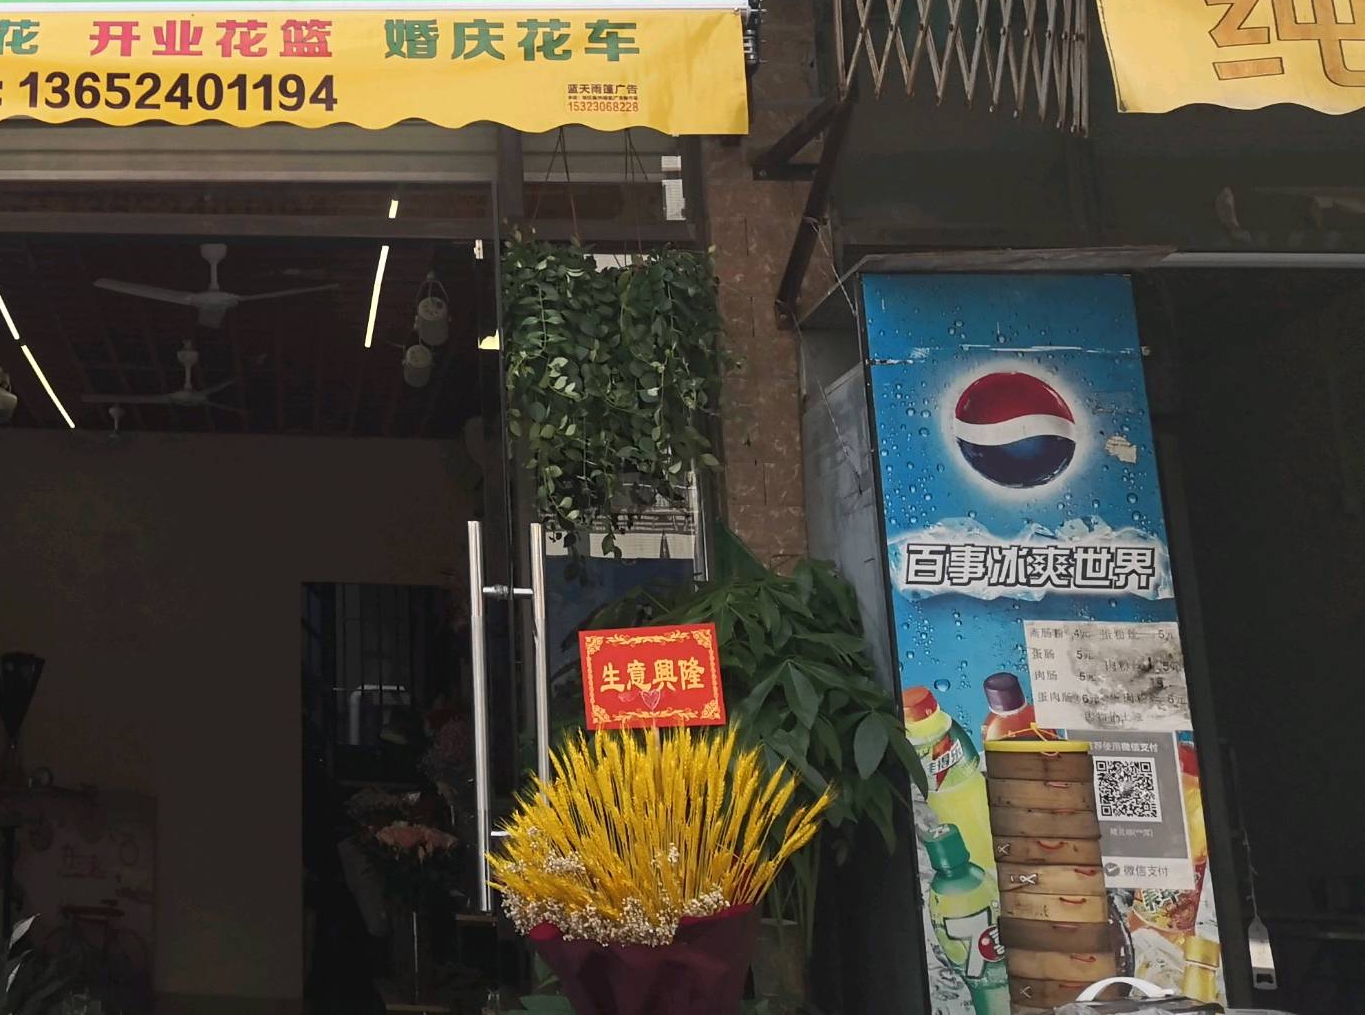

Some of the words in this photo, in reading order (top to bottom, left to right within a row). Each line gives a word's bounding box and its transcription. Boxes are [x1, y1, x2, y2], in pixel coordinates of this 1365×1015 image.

[89, 19, 333, 59] 开业花篮
[384, 18, 641, 62] 婚庆花车
[568, 101, 639, 112] 15323068228
[906, 543, 1156, 590] 百事冰爽世界
[600, 656, 705, 693] 生意興隆
[1123, 865, 1169, 877] 微信支付
